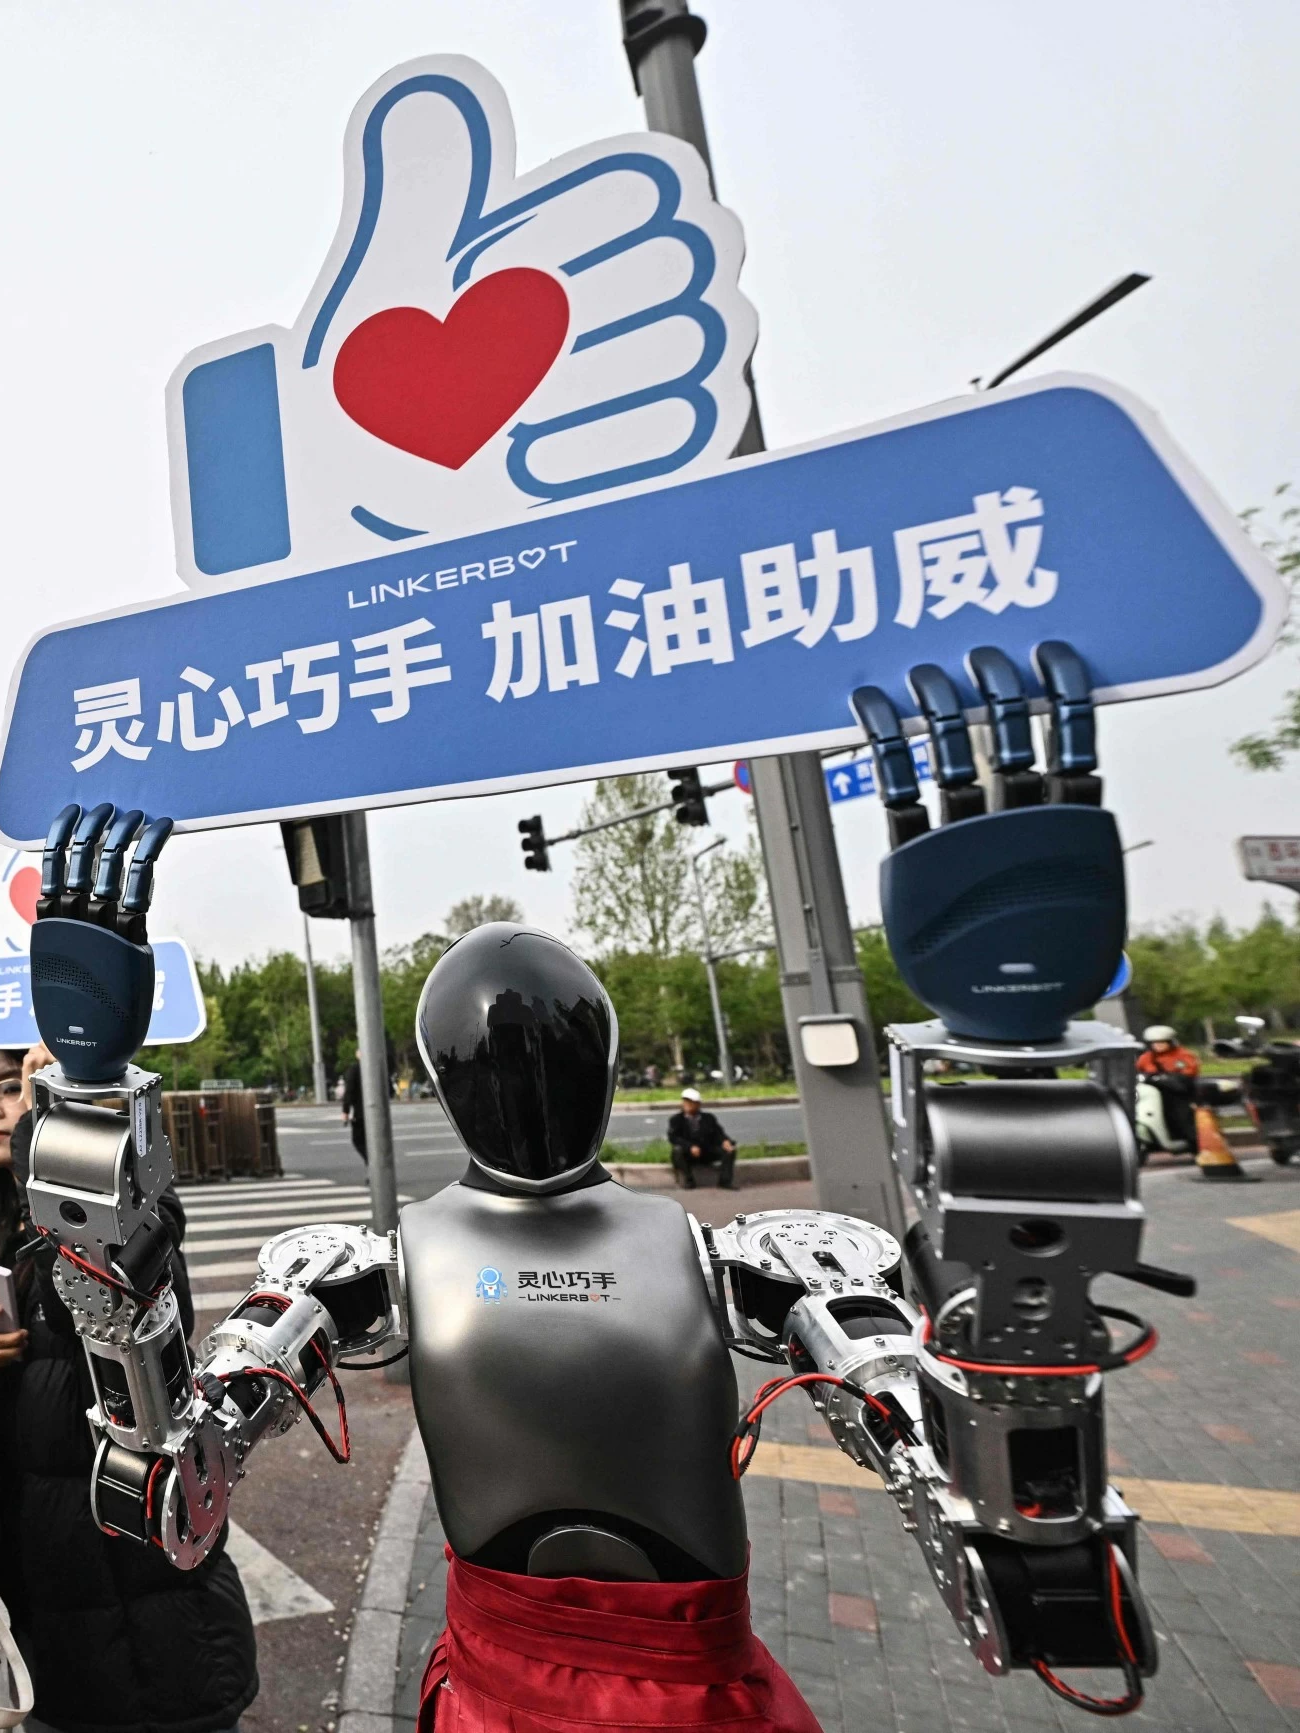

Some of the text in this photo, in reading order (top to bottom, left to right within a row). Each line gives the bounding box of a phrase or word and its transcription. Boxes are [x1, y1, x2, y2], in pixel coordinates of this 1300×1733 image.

[70, 486, 1058, 773] 灵心巧手 加油助威
[517, 1270, 617, 1290] 灵心巧手
